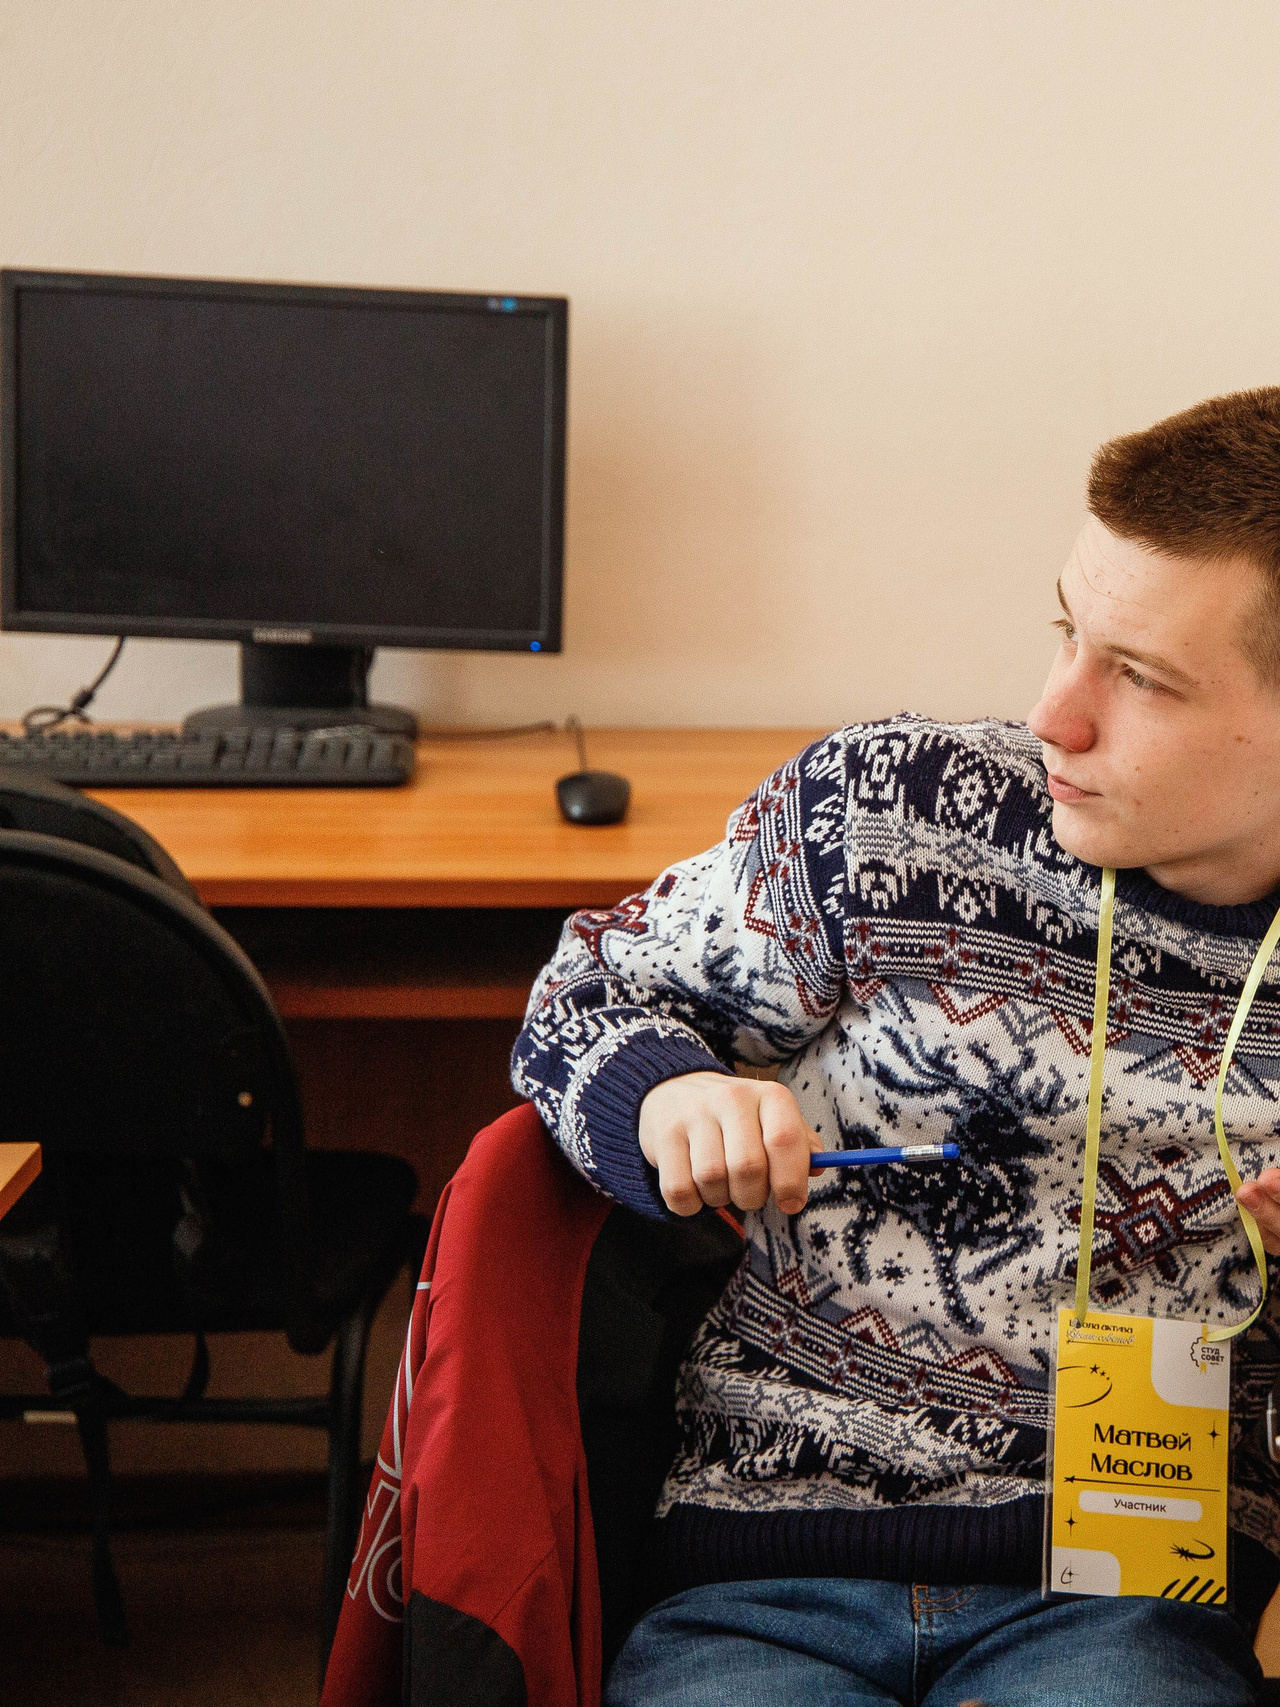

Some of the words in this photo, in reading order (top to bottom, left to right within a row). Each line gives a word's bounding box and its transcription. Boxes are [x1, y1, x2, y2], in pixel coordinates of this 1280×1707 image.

[1069, 1319, 1100, 1330] ола
[1201, 1347, 1220, 1355] СТУД
[1201, 1354, 1225, 1362] СОВЕТ
[1093, 1423, 1192, 1451] Матвей
[1091, 1453, 1193, 1481] Маслов
[1113, 1498, 1167, 1513] Участник
